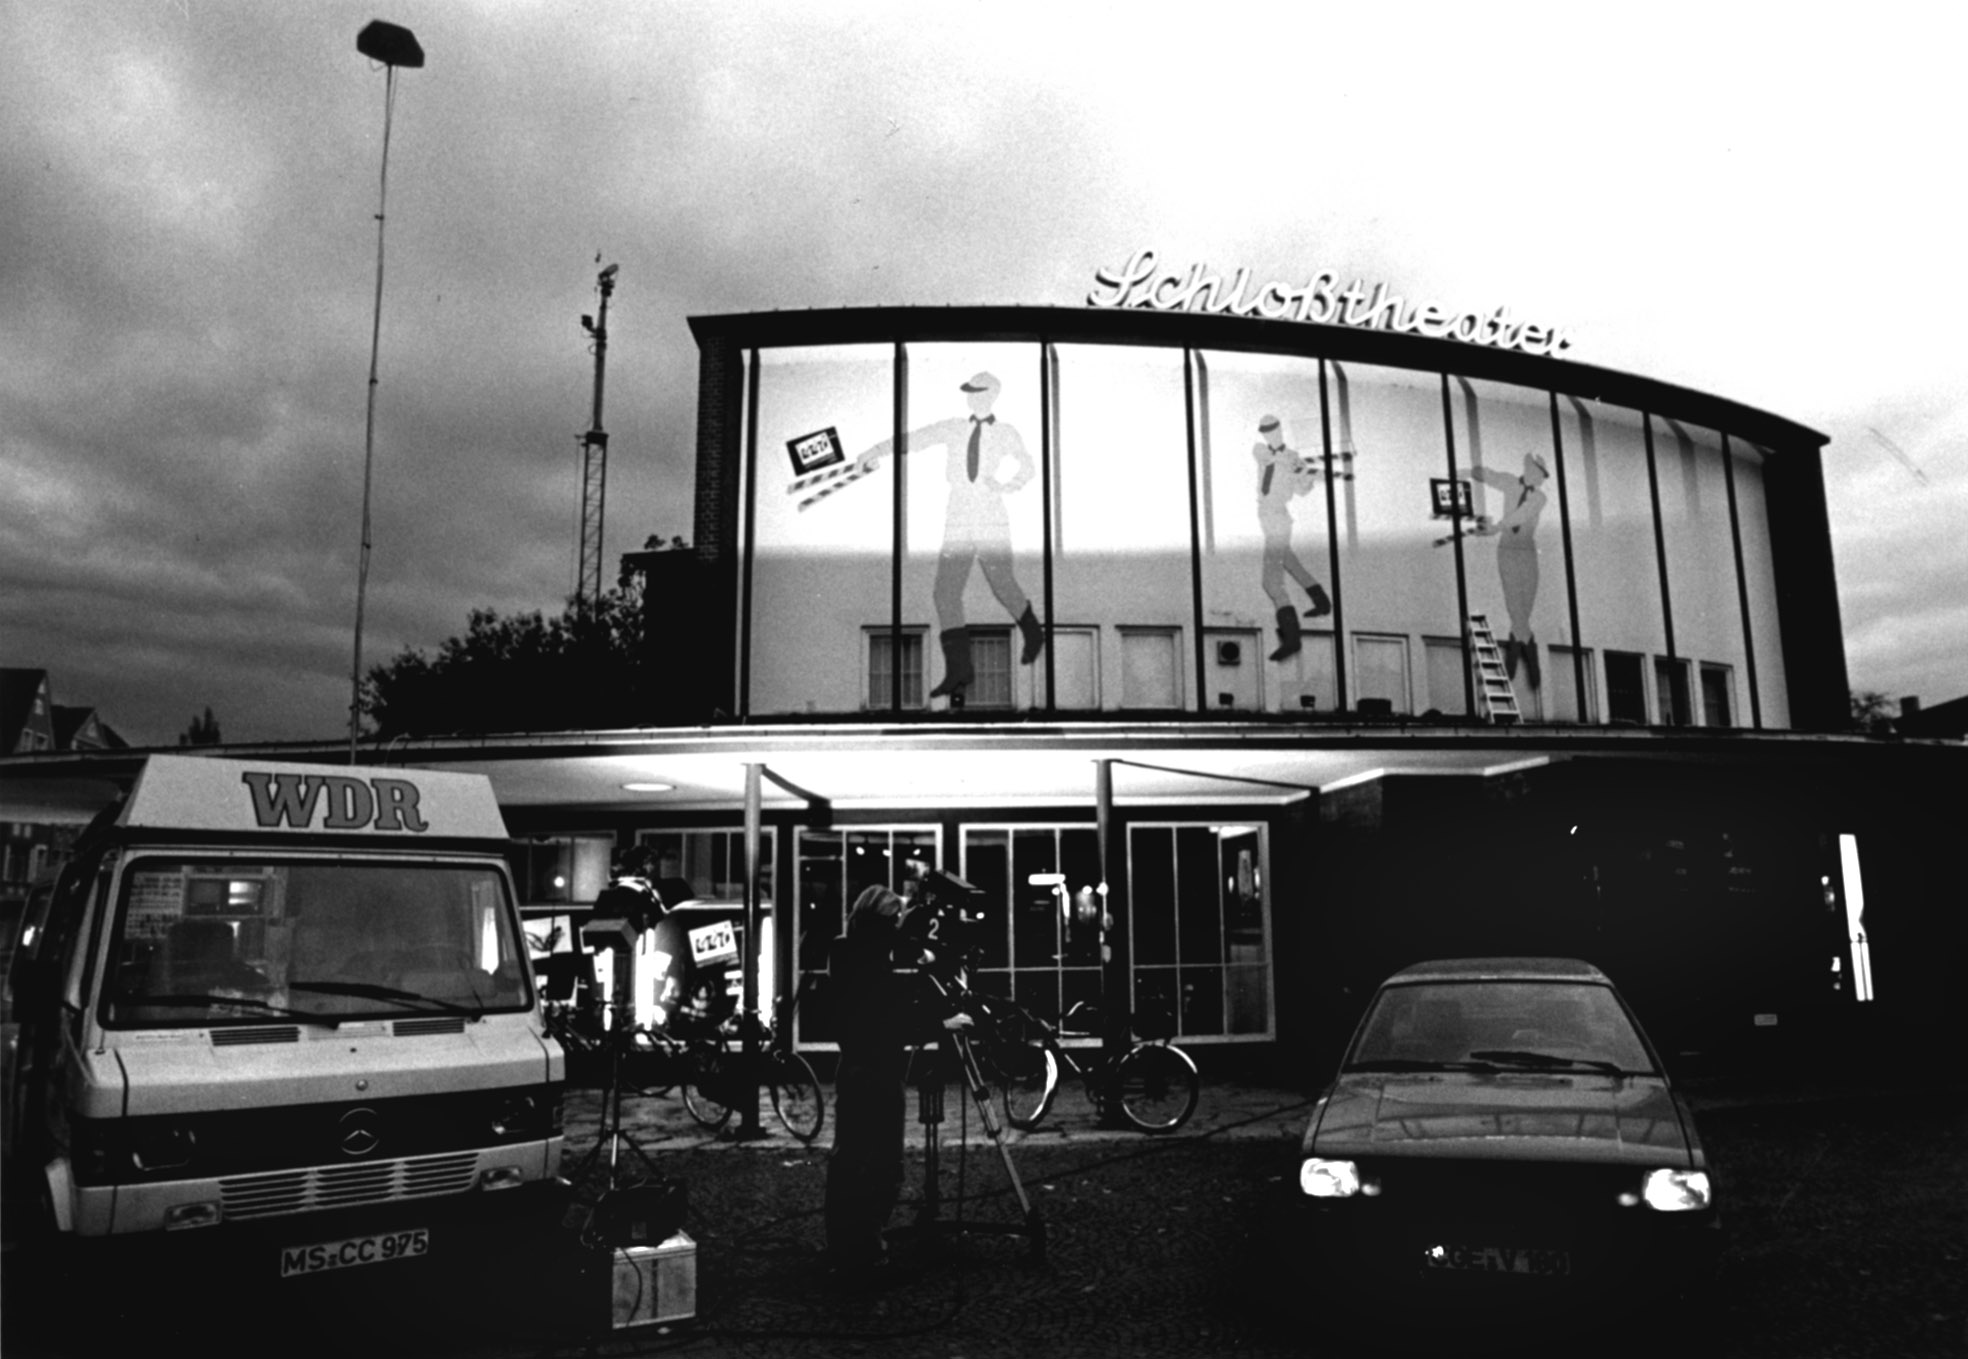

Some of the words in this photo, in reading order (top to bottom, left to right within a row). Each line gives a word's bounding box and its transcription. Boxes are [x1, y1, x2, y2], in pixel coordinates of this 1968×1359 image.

[1089, 249, 1573, 359] Schloßtheater
[242, 771, 429, 833] WDR
[927, 917, 940, 941] 2
[381, 1231, 428, 1259] 975
